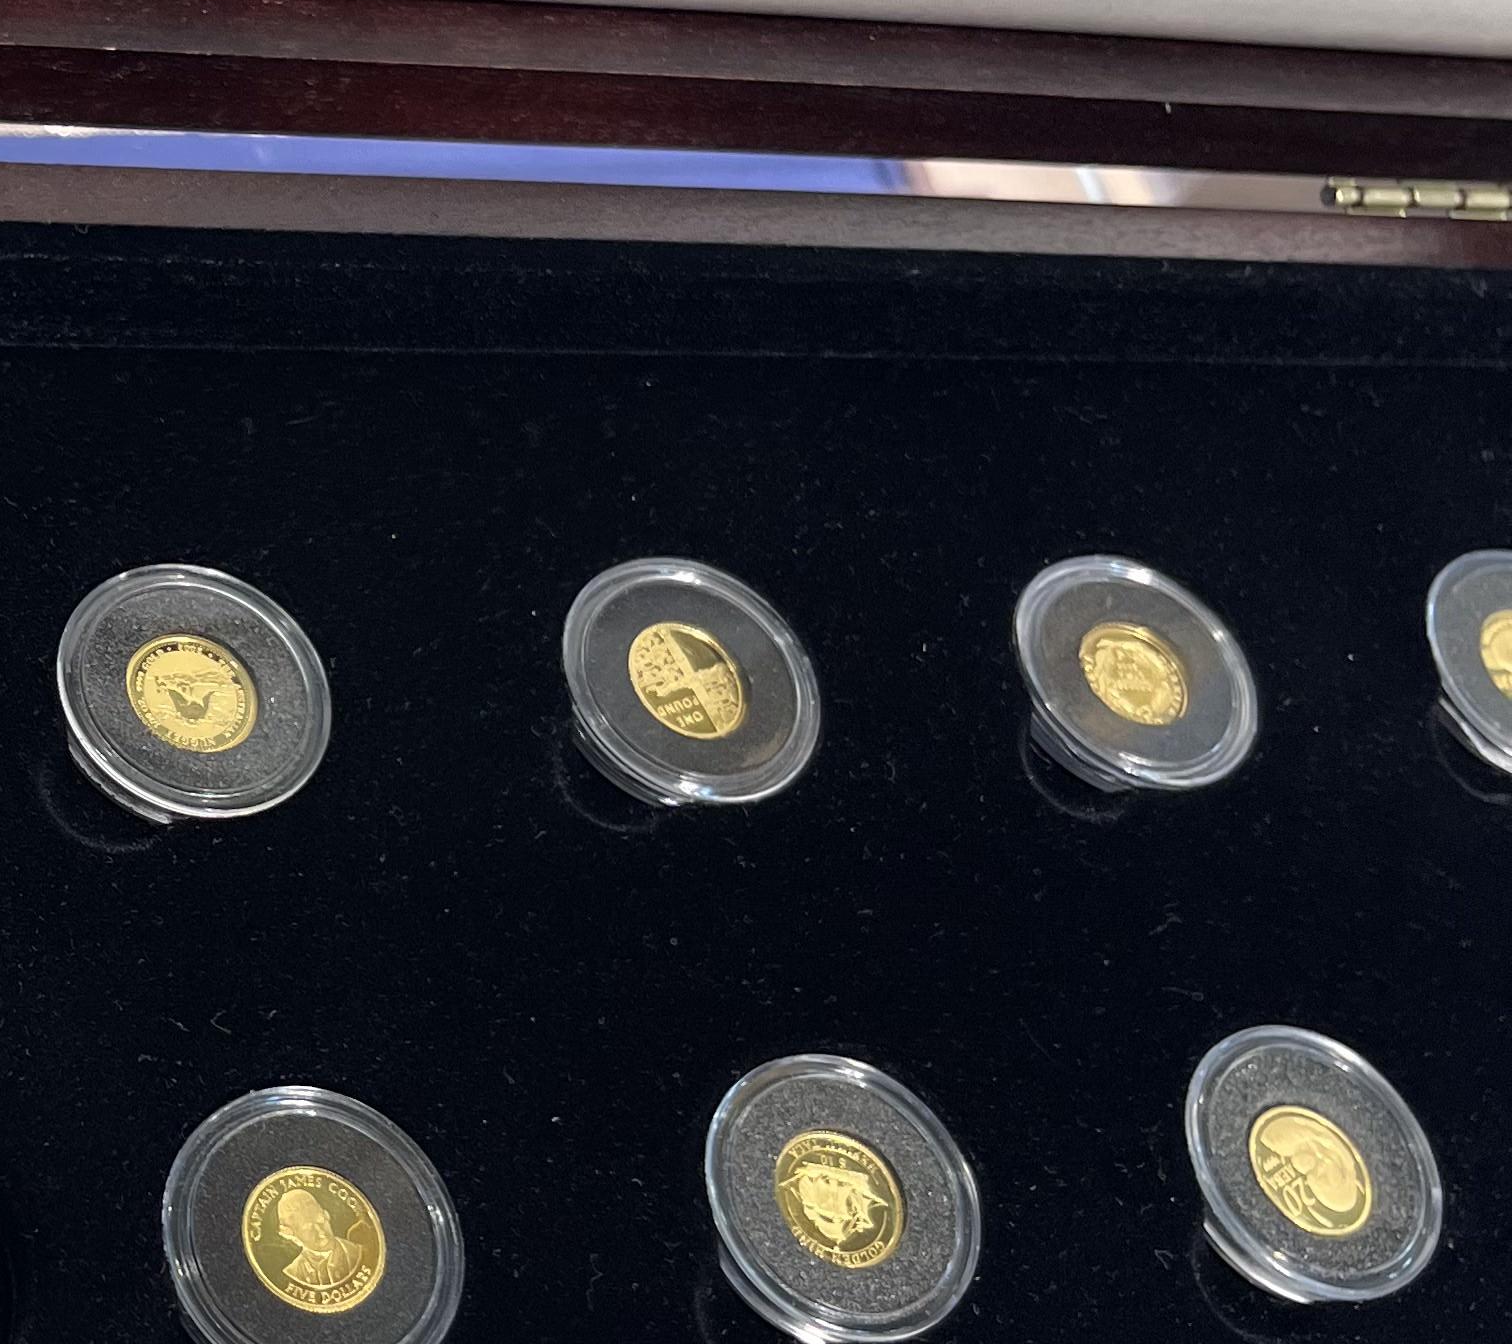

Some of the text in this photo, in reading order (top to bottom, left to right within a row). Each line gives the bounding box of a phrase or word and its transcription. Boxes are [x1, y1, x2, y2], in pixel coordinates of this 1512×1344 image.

[658, 695, 699, 716] POUND
[676, 711, 704, 728] ONE
[279, 1175, 322, 1192] JAMES
[1283, 1178, 1316, 1216] 20
[285, 1264, 371, 1304] FIVE DOLLARS
